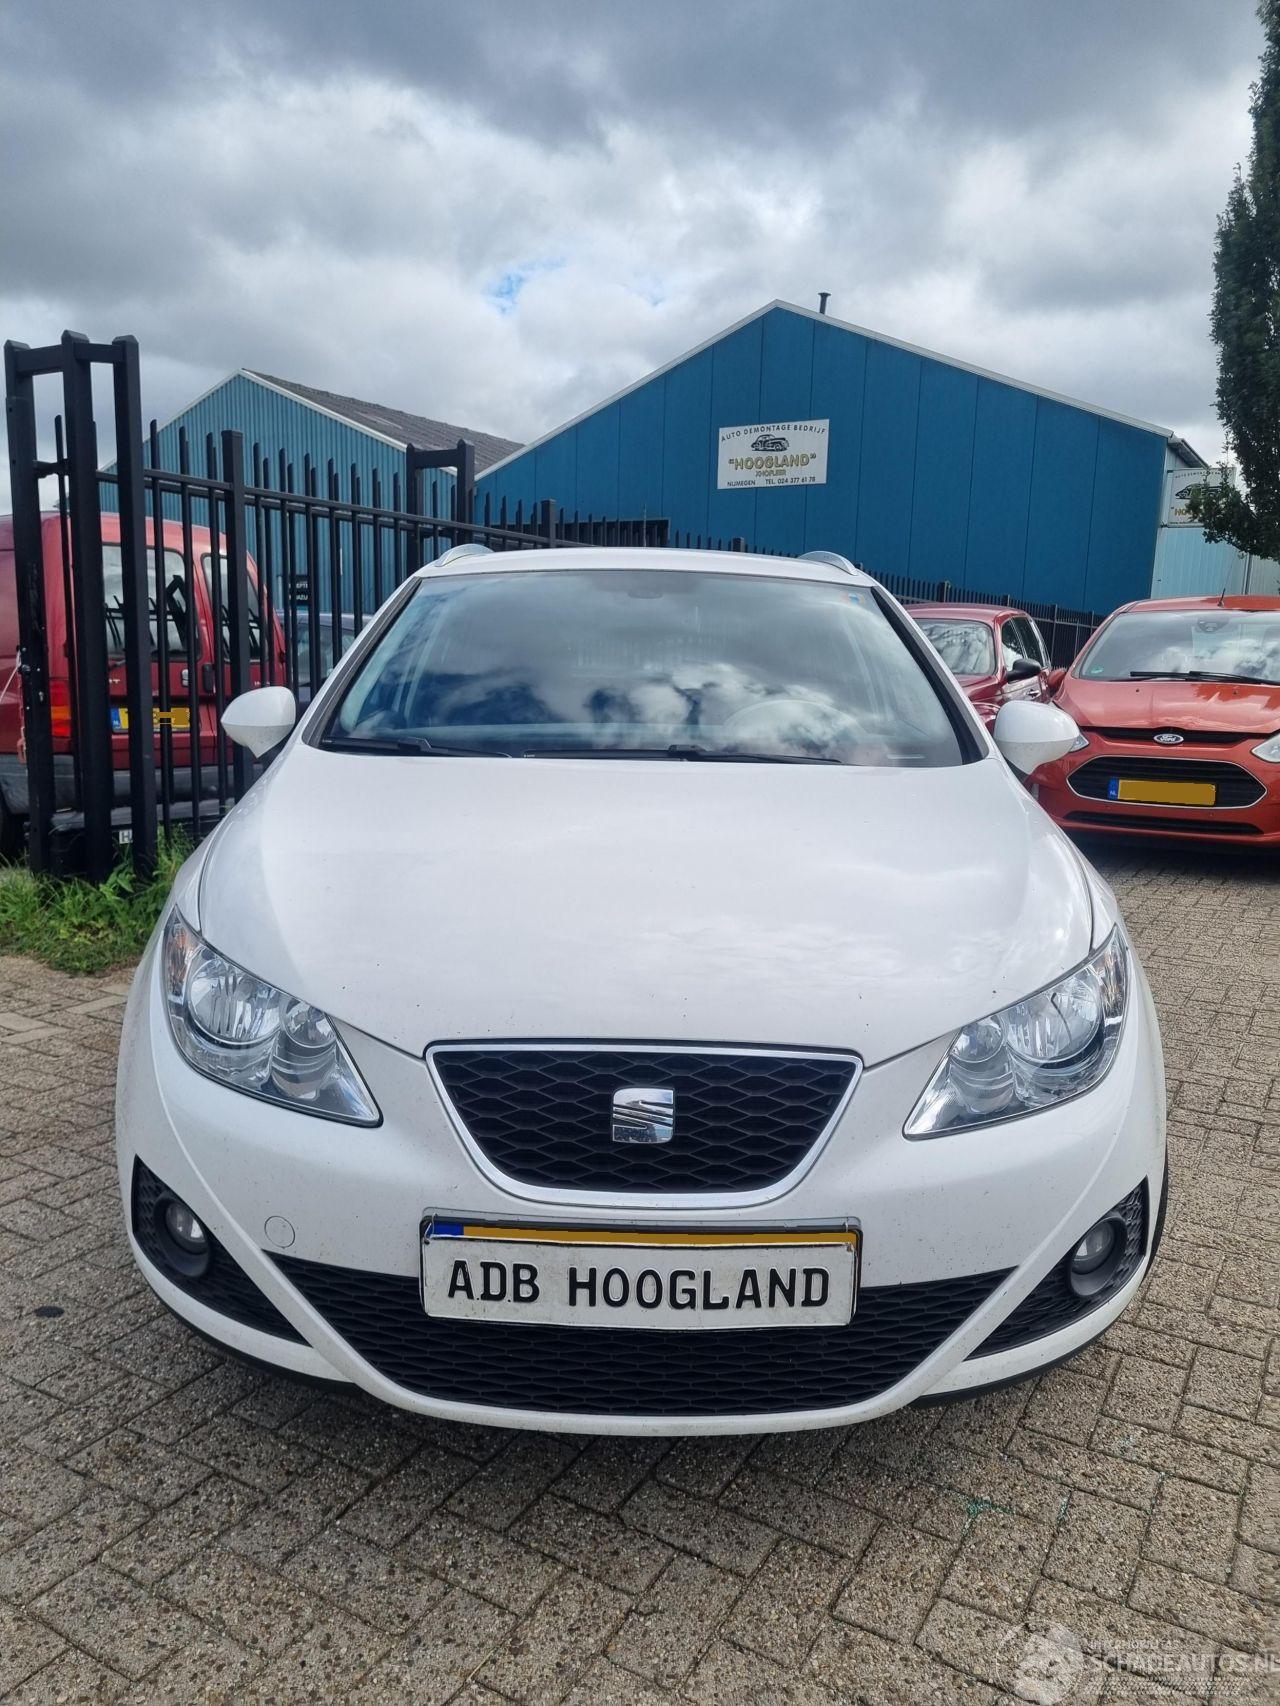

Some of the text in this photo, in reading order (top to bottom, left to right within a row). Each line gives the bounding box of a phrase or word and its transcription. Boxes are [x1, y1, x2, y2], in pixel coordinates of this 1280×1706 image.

[721, 424, 826, 442] AUTO DEMONTAGE BEDRIJF
[568, 1266, 831, 1311] HOOGLAND
